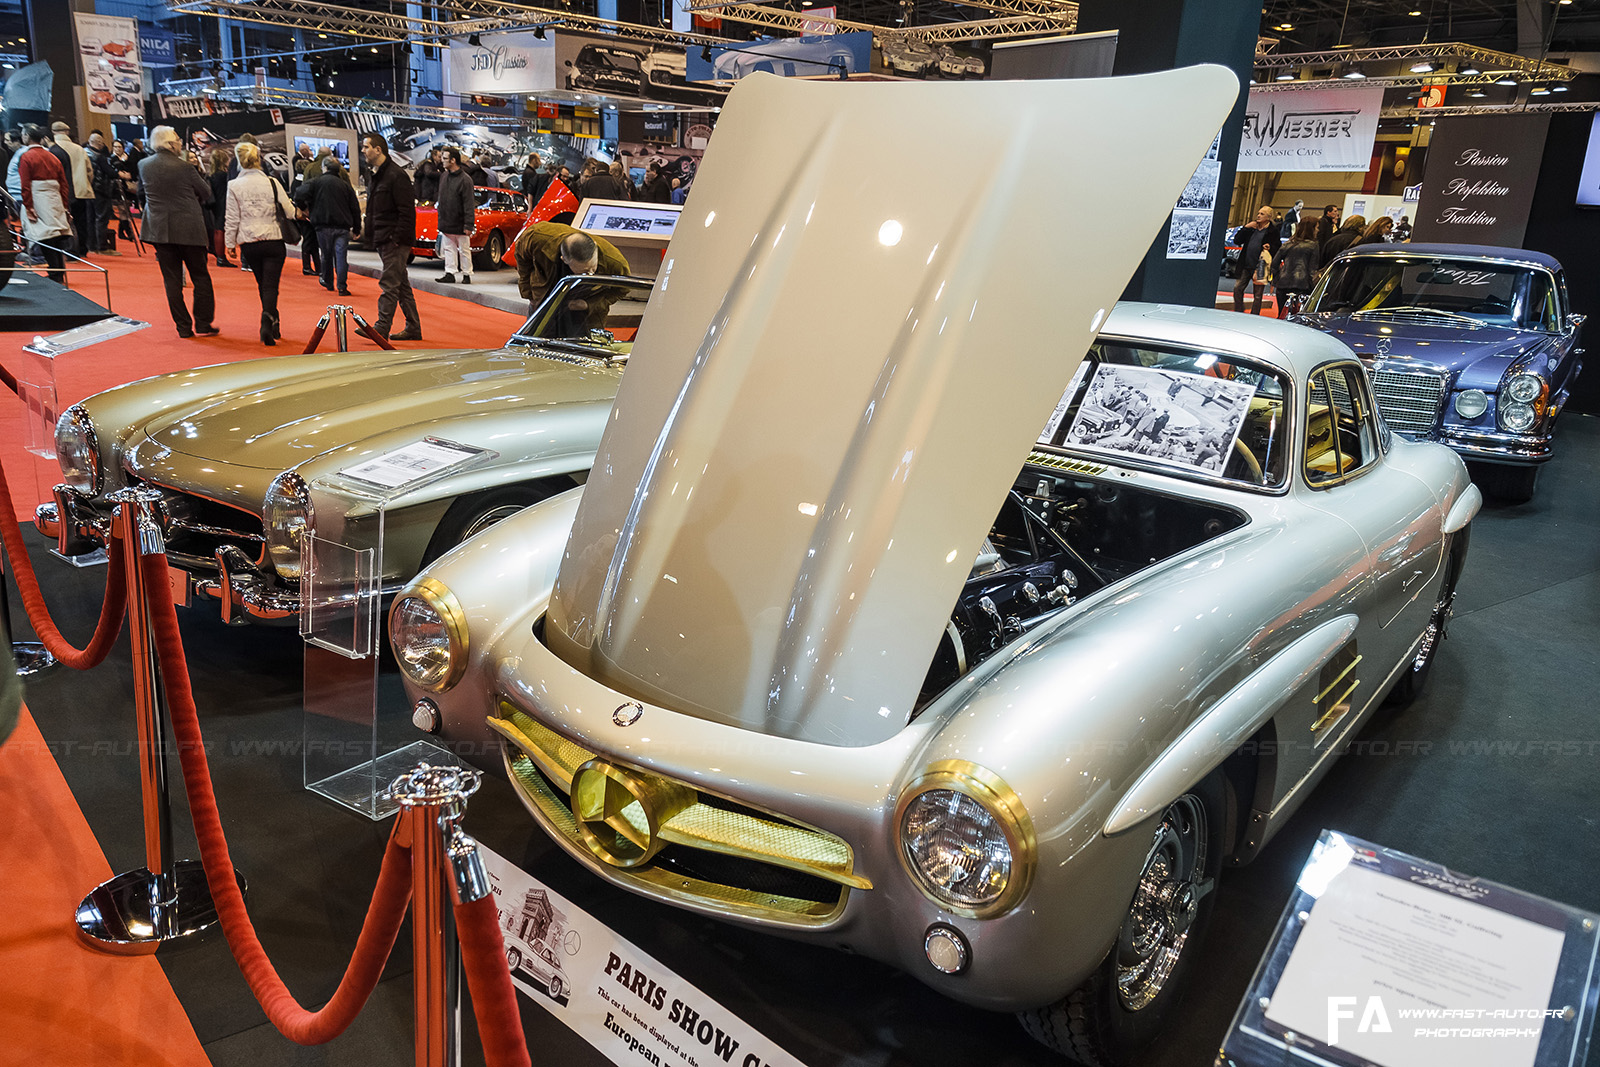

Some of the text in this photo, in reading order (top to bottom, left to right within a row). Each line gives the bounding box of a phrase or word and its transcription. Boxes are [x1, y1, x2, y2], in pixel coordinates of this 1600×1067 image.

[594, 73, 640, 86] JAGUAR
[1454, 148, 1509, 167] Passion
[1442, 177, 1510, 201] Perfektion
[1435, 206, 1497, 225] Tradition
[604, 951, 740, 1064] PARIS SHOW
[597, 986, 610, 1001] This
[611, 999, 621, 1009] car
[621, 1004, 632, 1018] has
[633, 1013, 648, 1030] been
[649, 1026, 680, 1054] displayed
[679, 1051, 688, 1060] at
[603, 1011, 661, 1067] European
